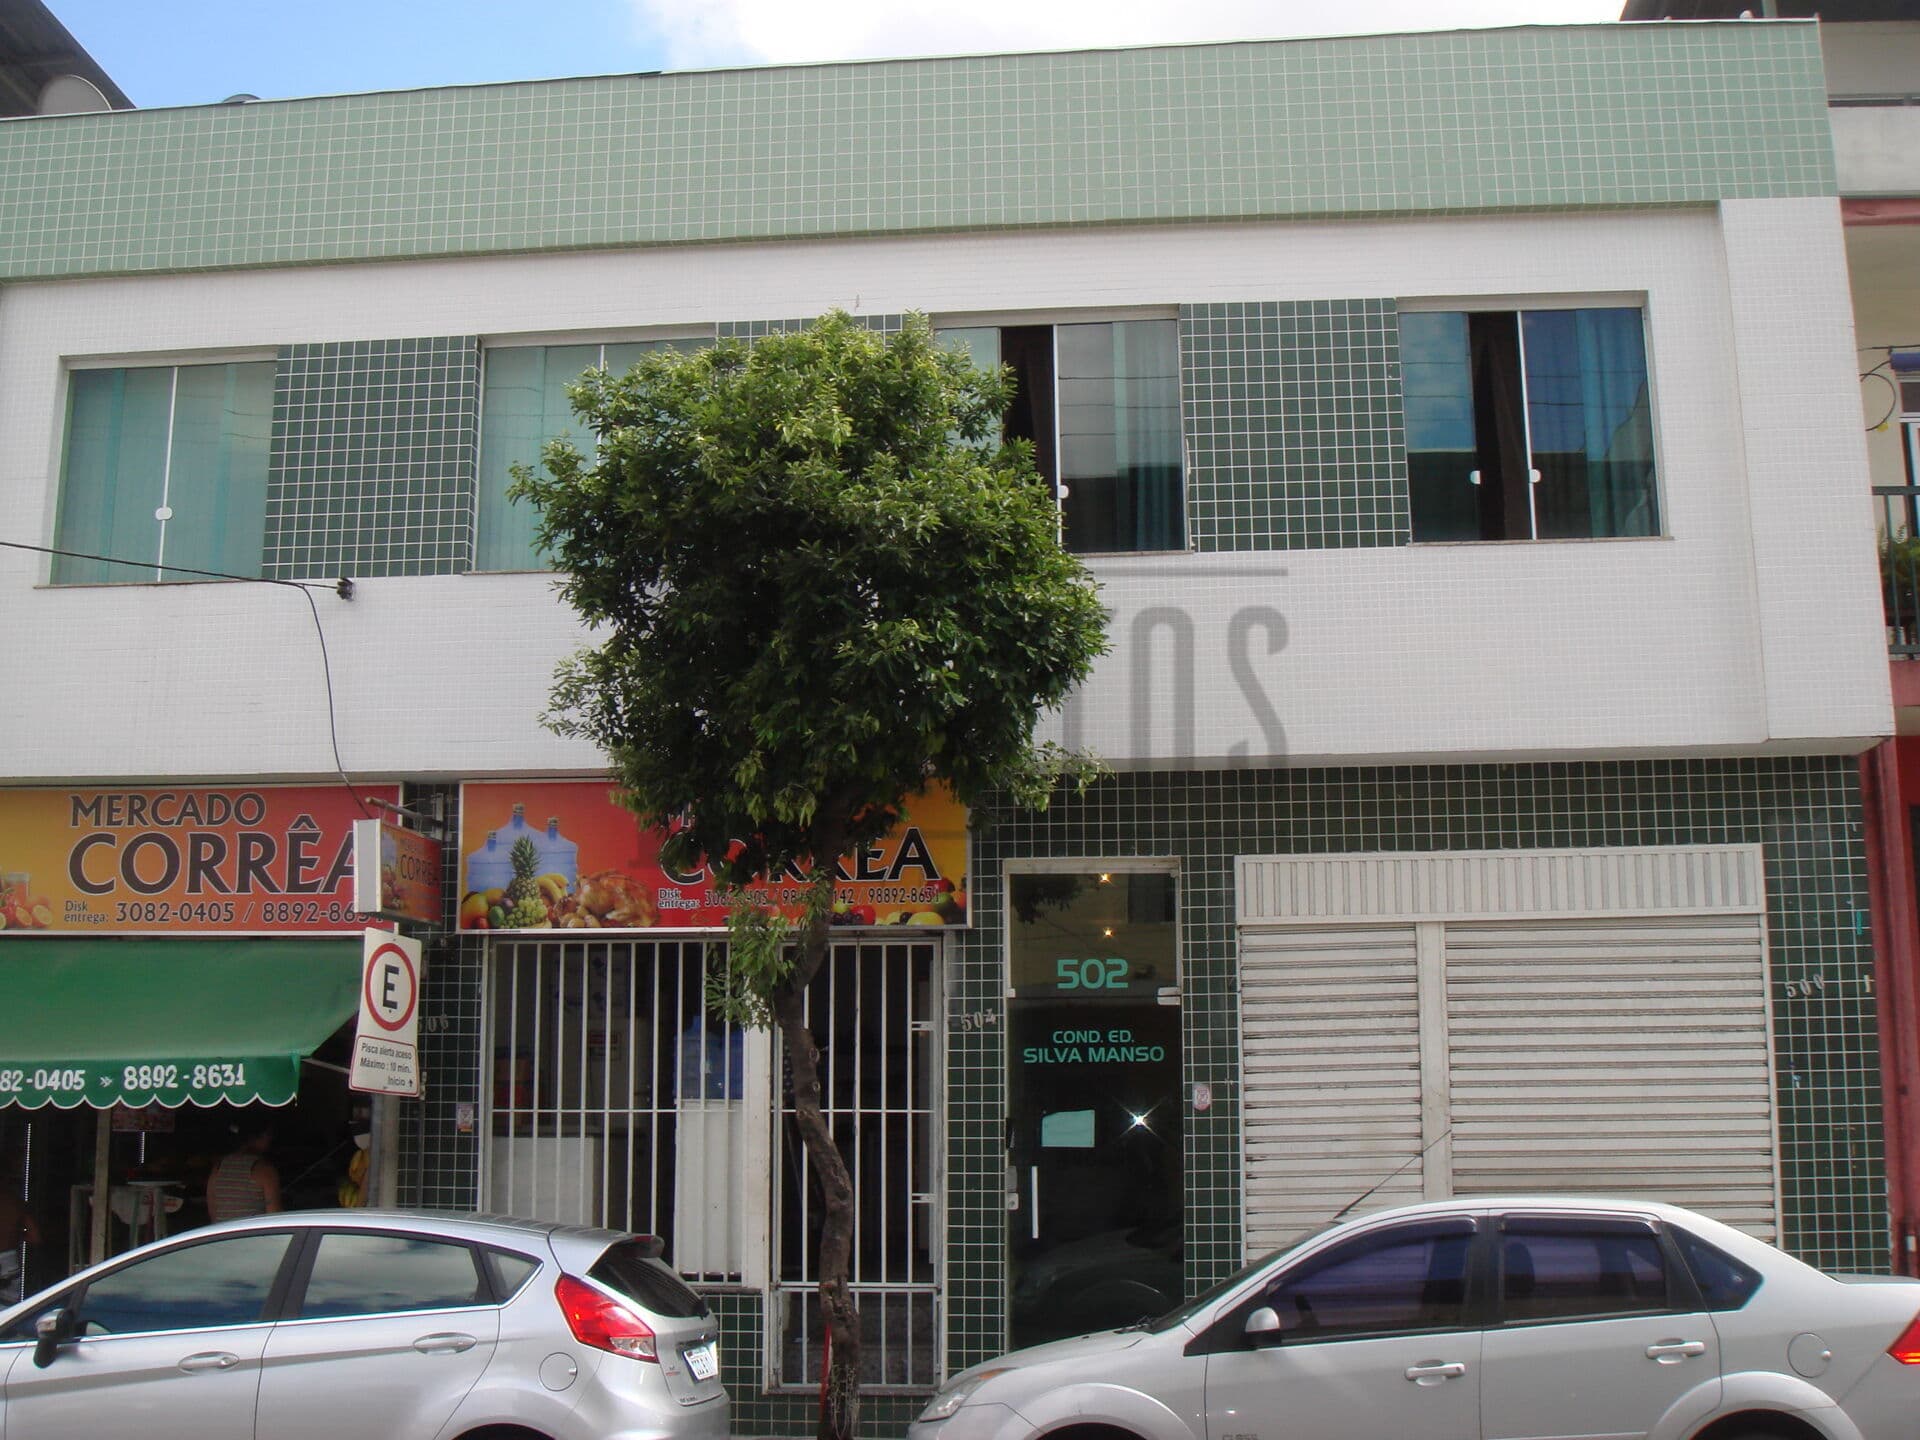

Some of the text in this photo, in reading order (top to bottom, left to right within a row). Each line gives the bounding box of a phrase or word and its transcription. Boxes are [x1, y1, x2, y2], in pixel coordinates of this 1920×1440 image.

[71, 792, 266, 828] MERCADO
[69, 813, 354, 895] CORRÊA
[659, 888, 680, 899] Disk
[63, 911, 109, 924] entrega:
[115, 901, 235, 923] 3082-0405
[65, 901, 88, 912] Disk
[1056, 958, 1129, 989] 502
[382, 964, 400, 1010] E
[1053, 1029, 1135, 1044] COND. ED.
[361, 1042, 379, 1054] Pisca
[1023, 1046, 1165, 1063] SILVA MANSO
